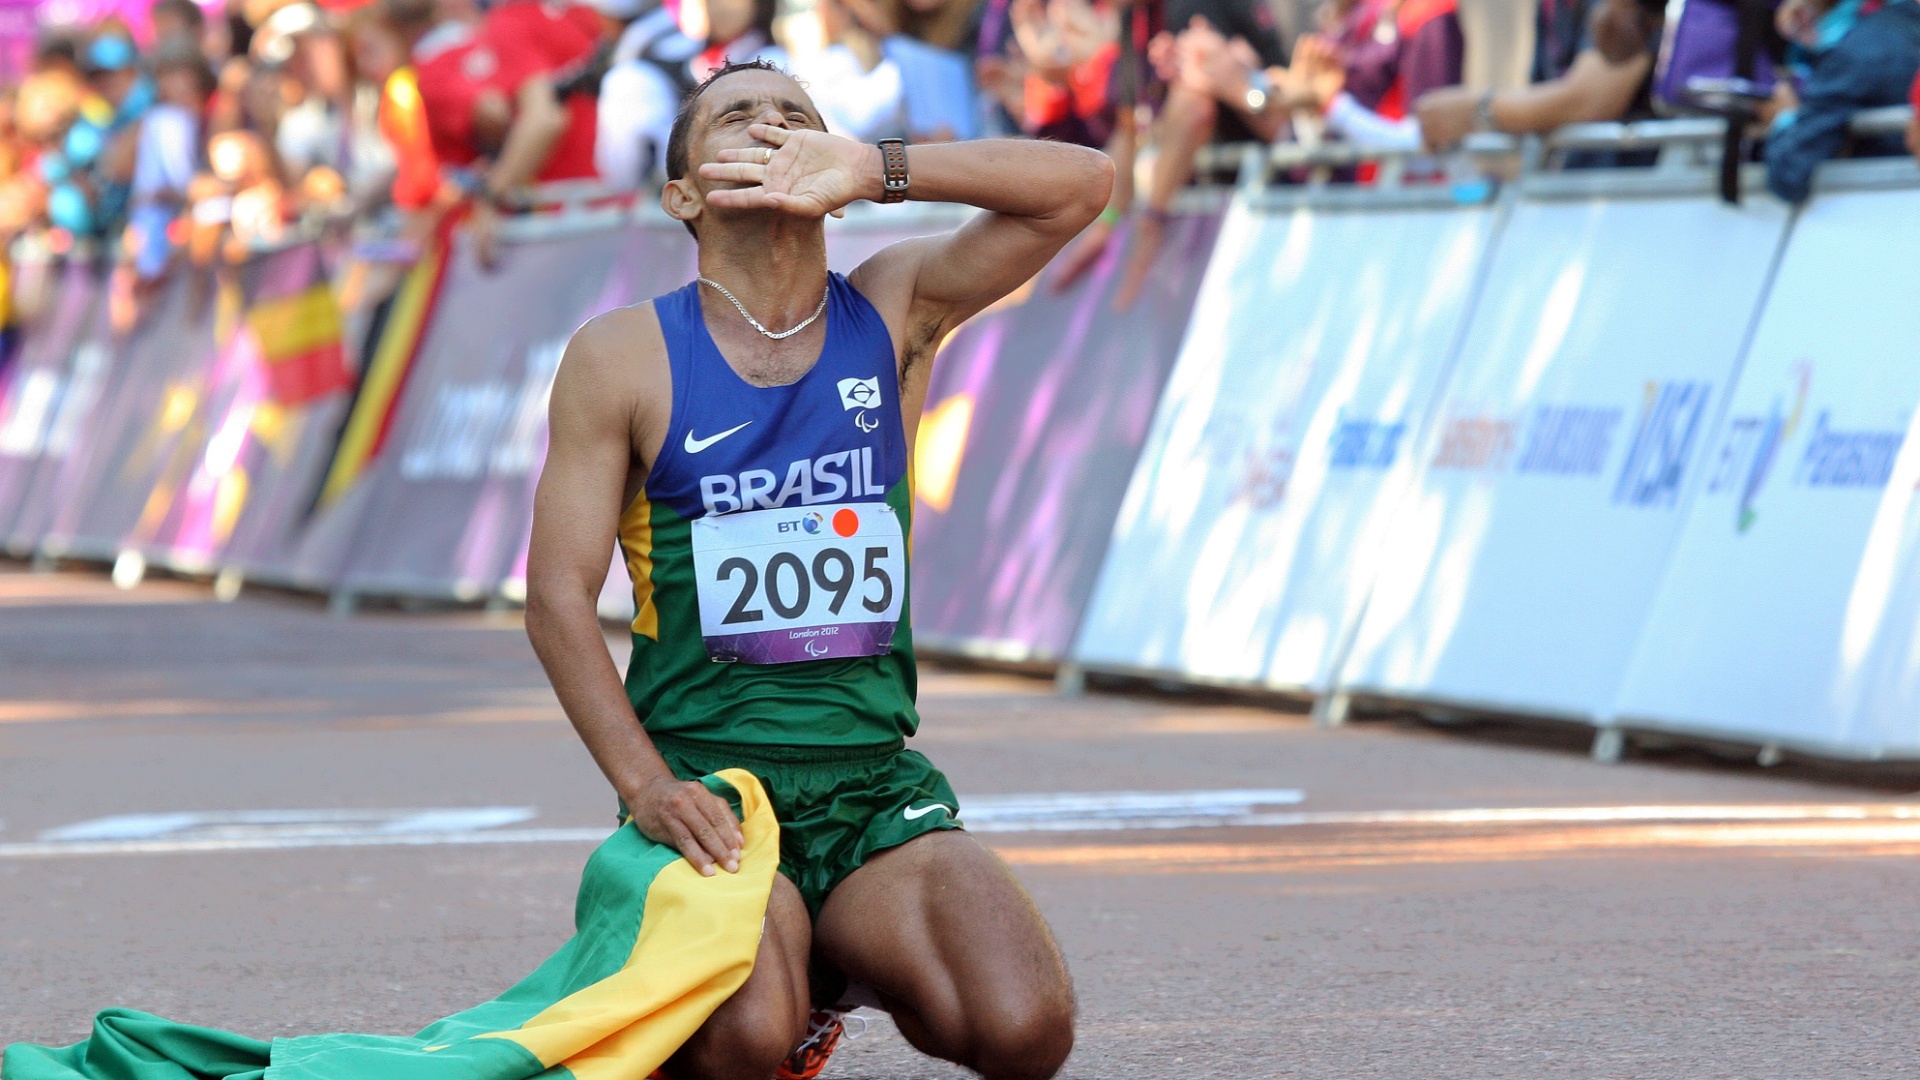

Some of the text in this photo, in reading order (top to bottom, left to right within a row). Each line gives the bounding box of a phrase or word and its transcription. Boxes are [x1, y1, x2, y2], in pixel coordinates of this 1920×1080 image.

[700, 446, 885, 517] BRASIL
[777, 520, 801, 533] BT
[716, 546, 893, 625] 2095
[789, 626, 839, 640] London 2012
